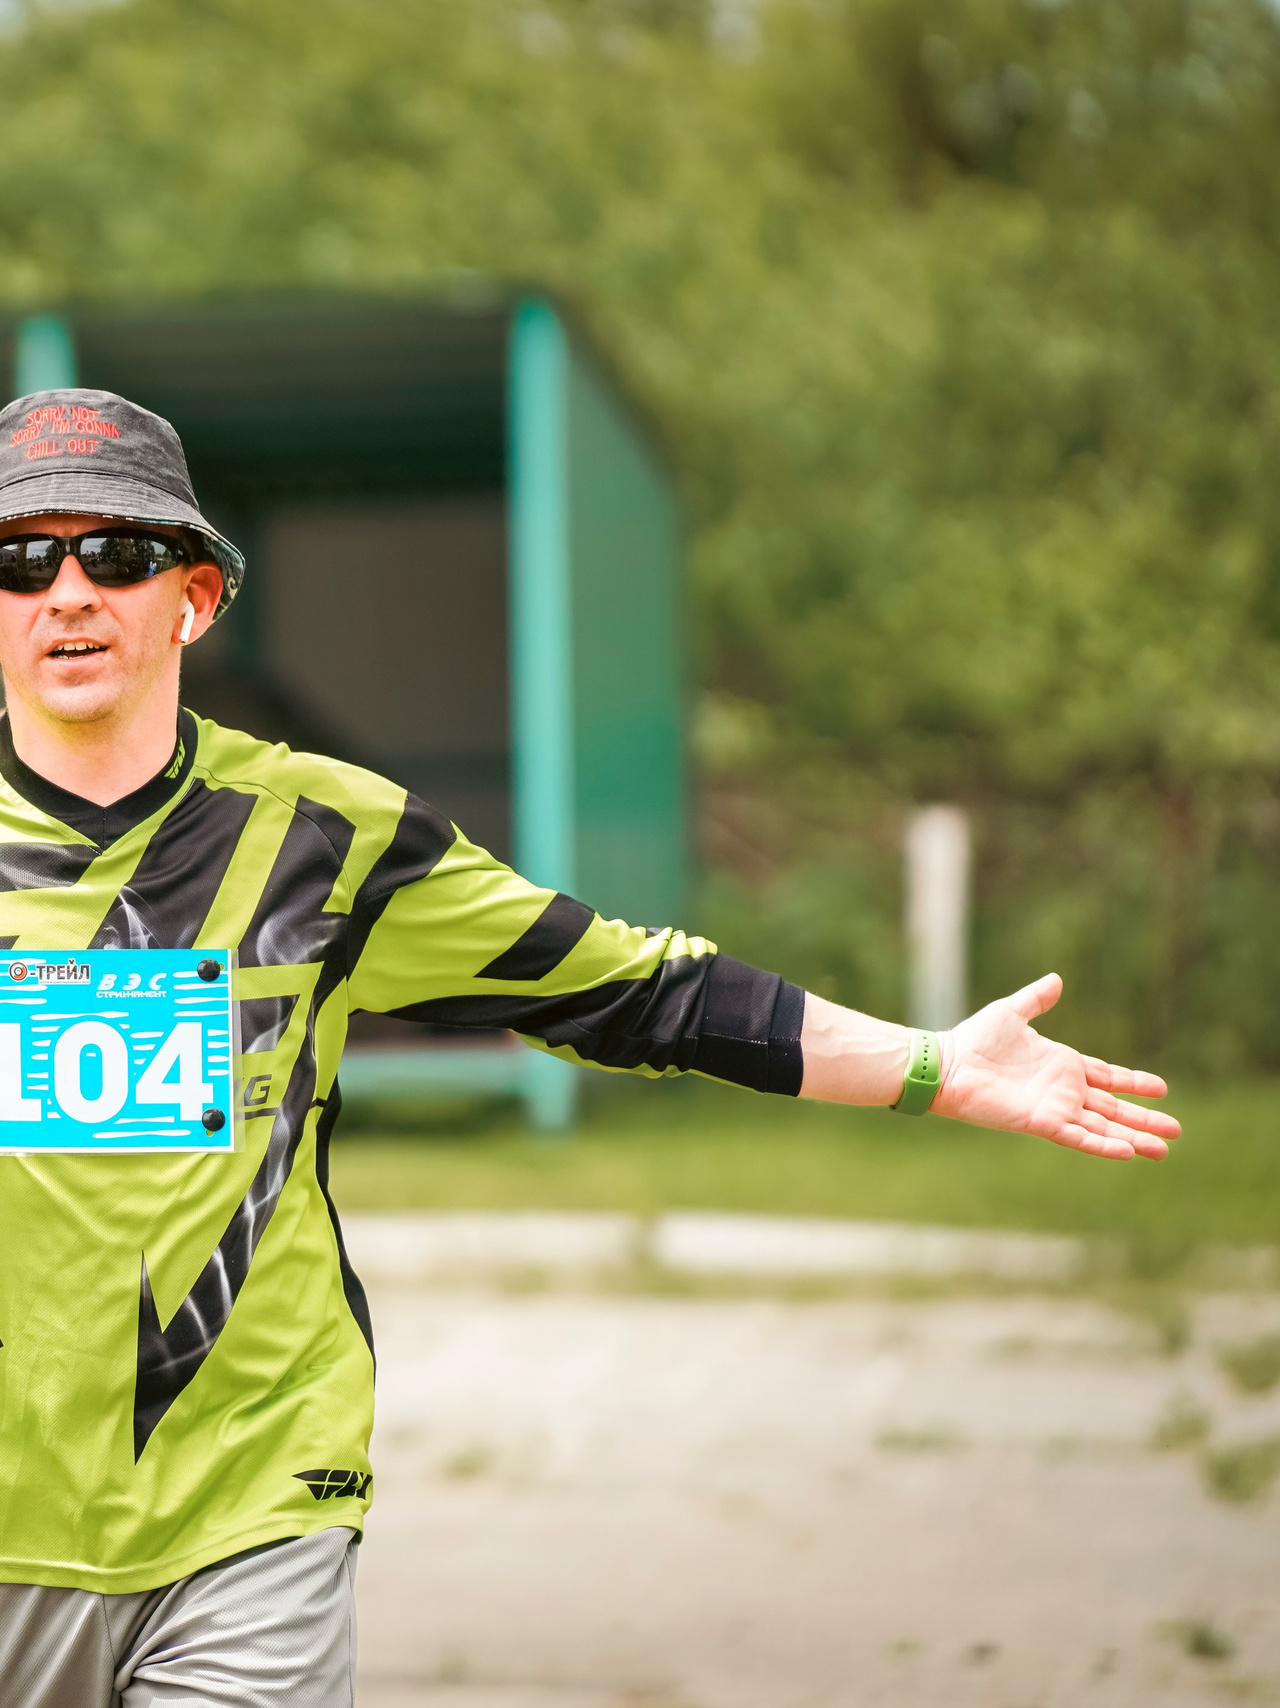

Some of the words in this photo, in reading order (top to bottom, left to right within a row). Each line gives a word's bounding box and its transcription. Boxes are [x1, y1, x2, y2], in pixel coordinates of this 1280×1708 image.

[27, 406, 65, 426] SORRY
[71, 406, 102, 421] NOT
[10, 422, 44, 448] SORRY
[51, 420, 71, 434] I'M
[75, 421, 120, 438] GONNA
[26, 440, 62, 460] CHILL
[67, 439, 99, 454] OUT
